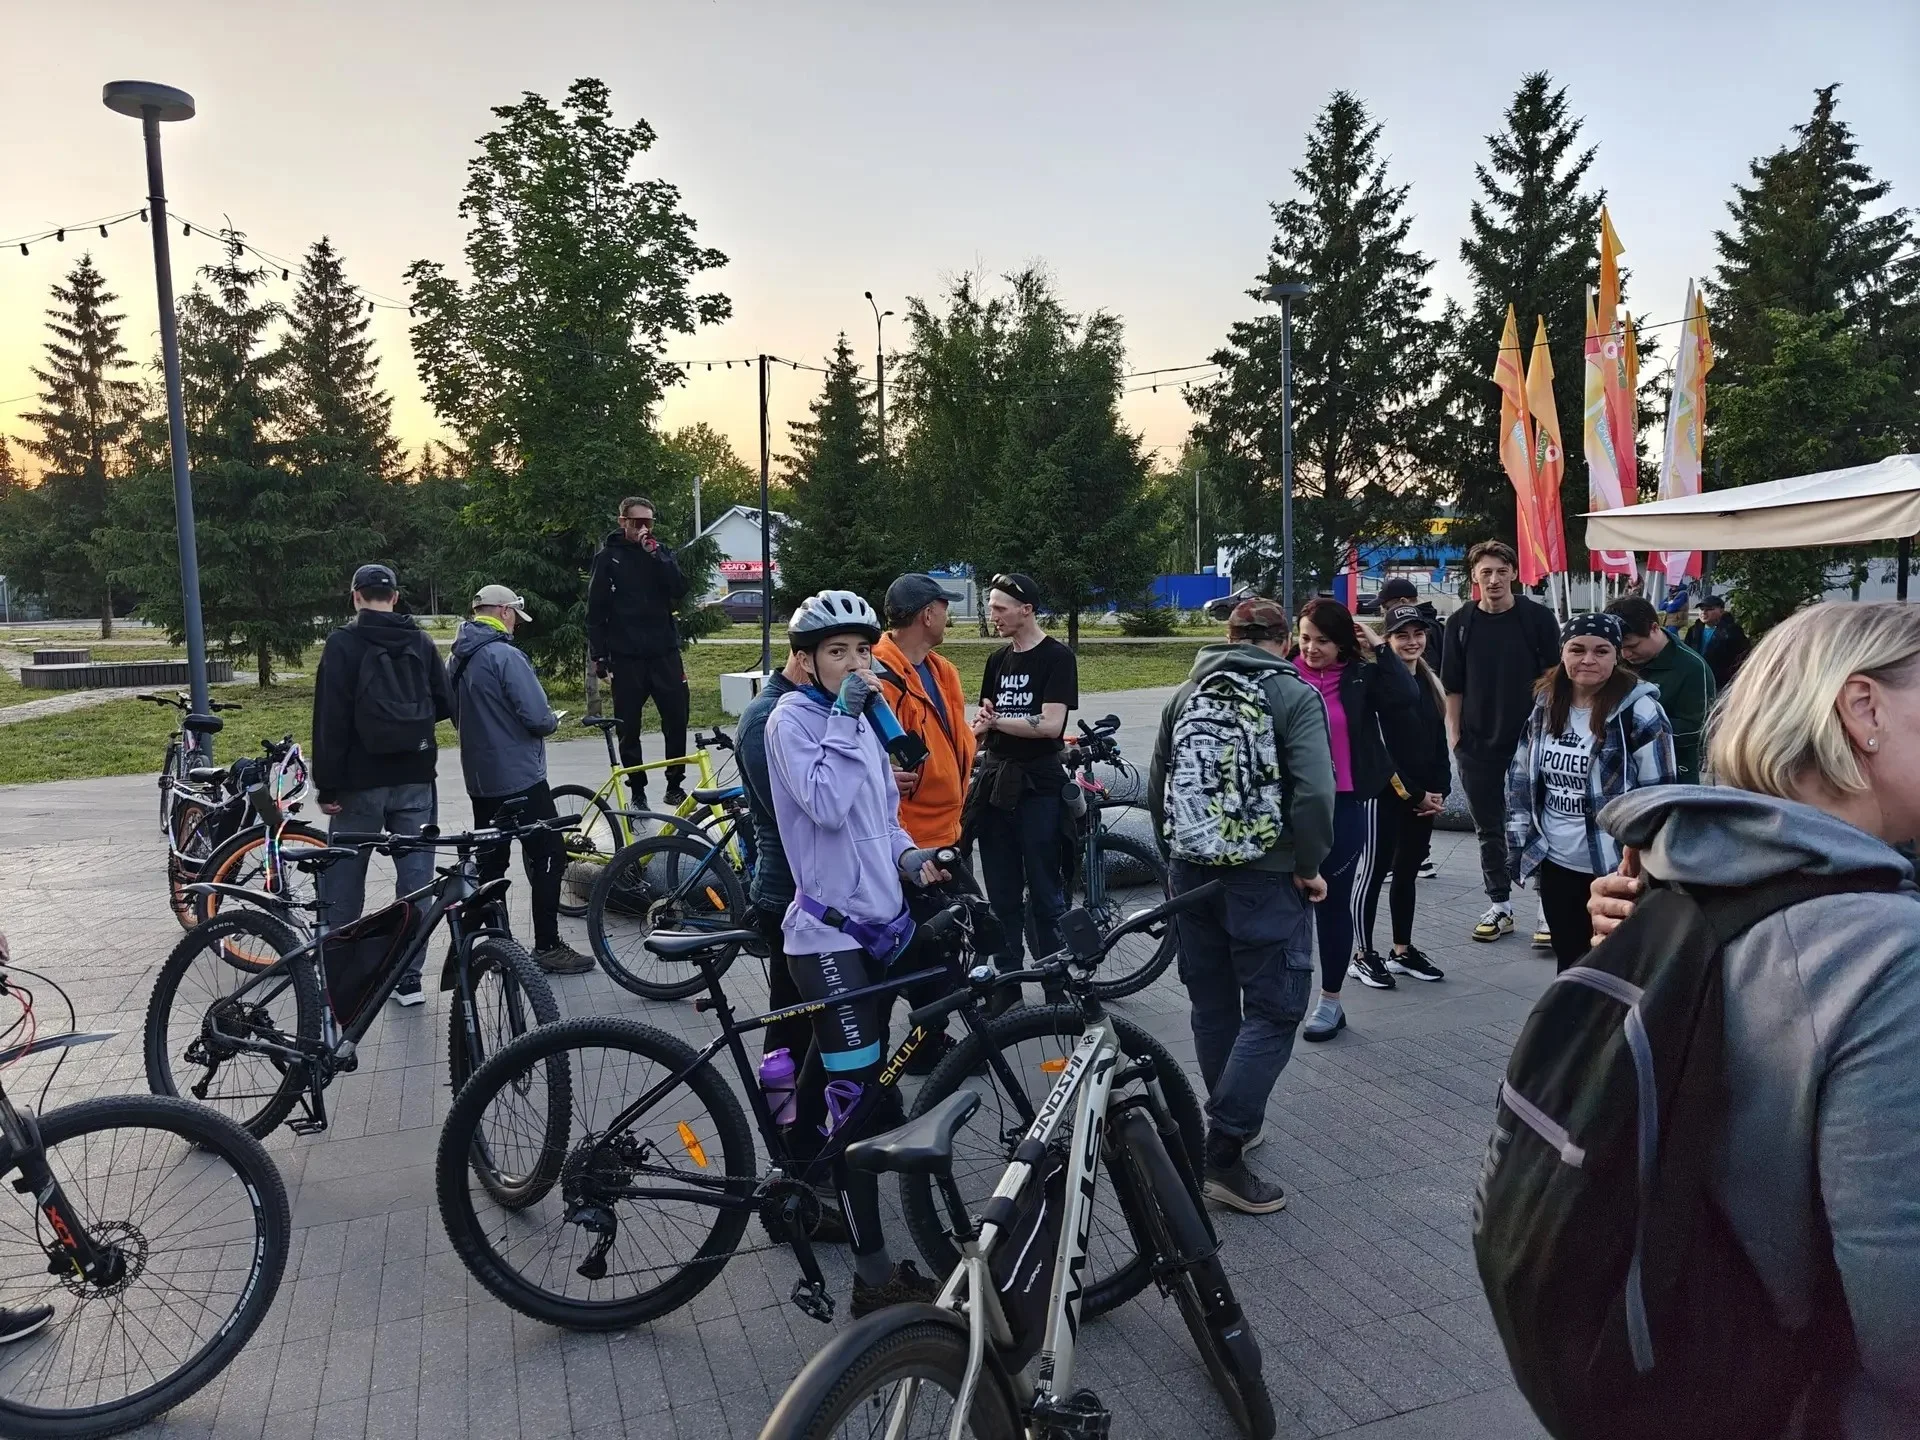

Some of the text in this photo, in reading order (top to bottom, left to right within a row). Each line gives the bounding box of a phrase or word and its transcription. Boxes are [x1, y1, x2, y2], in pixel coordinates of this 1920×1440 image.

[1001, 674, 1029, 690] ИЩУ
[996, 691, 1033, 706] ЖЕНУ
[1540, 749, 1589, 774] РОЛЕВ
[208, 922, 235, 932] KENDA
[879, 1025, 928, 1087] SHULZ
[46, 1205, 78, 1249] XCT
